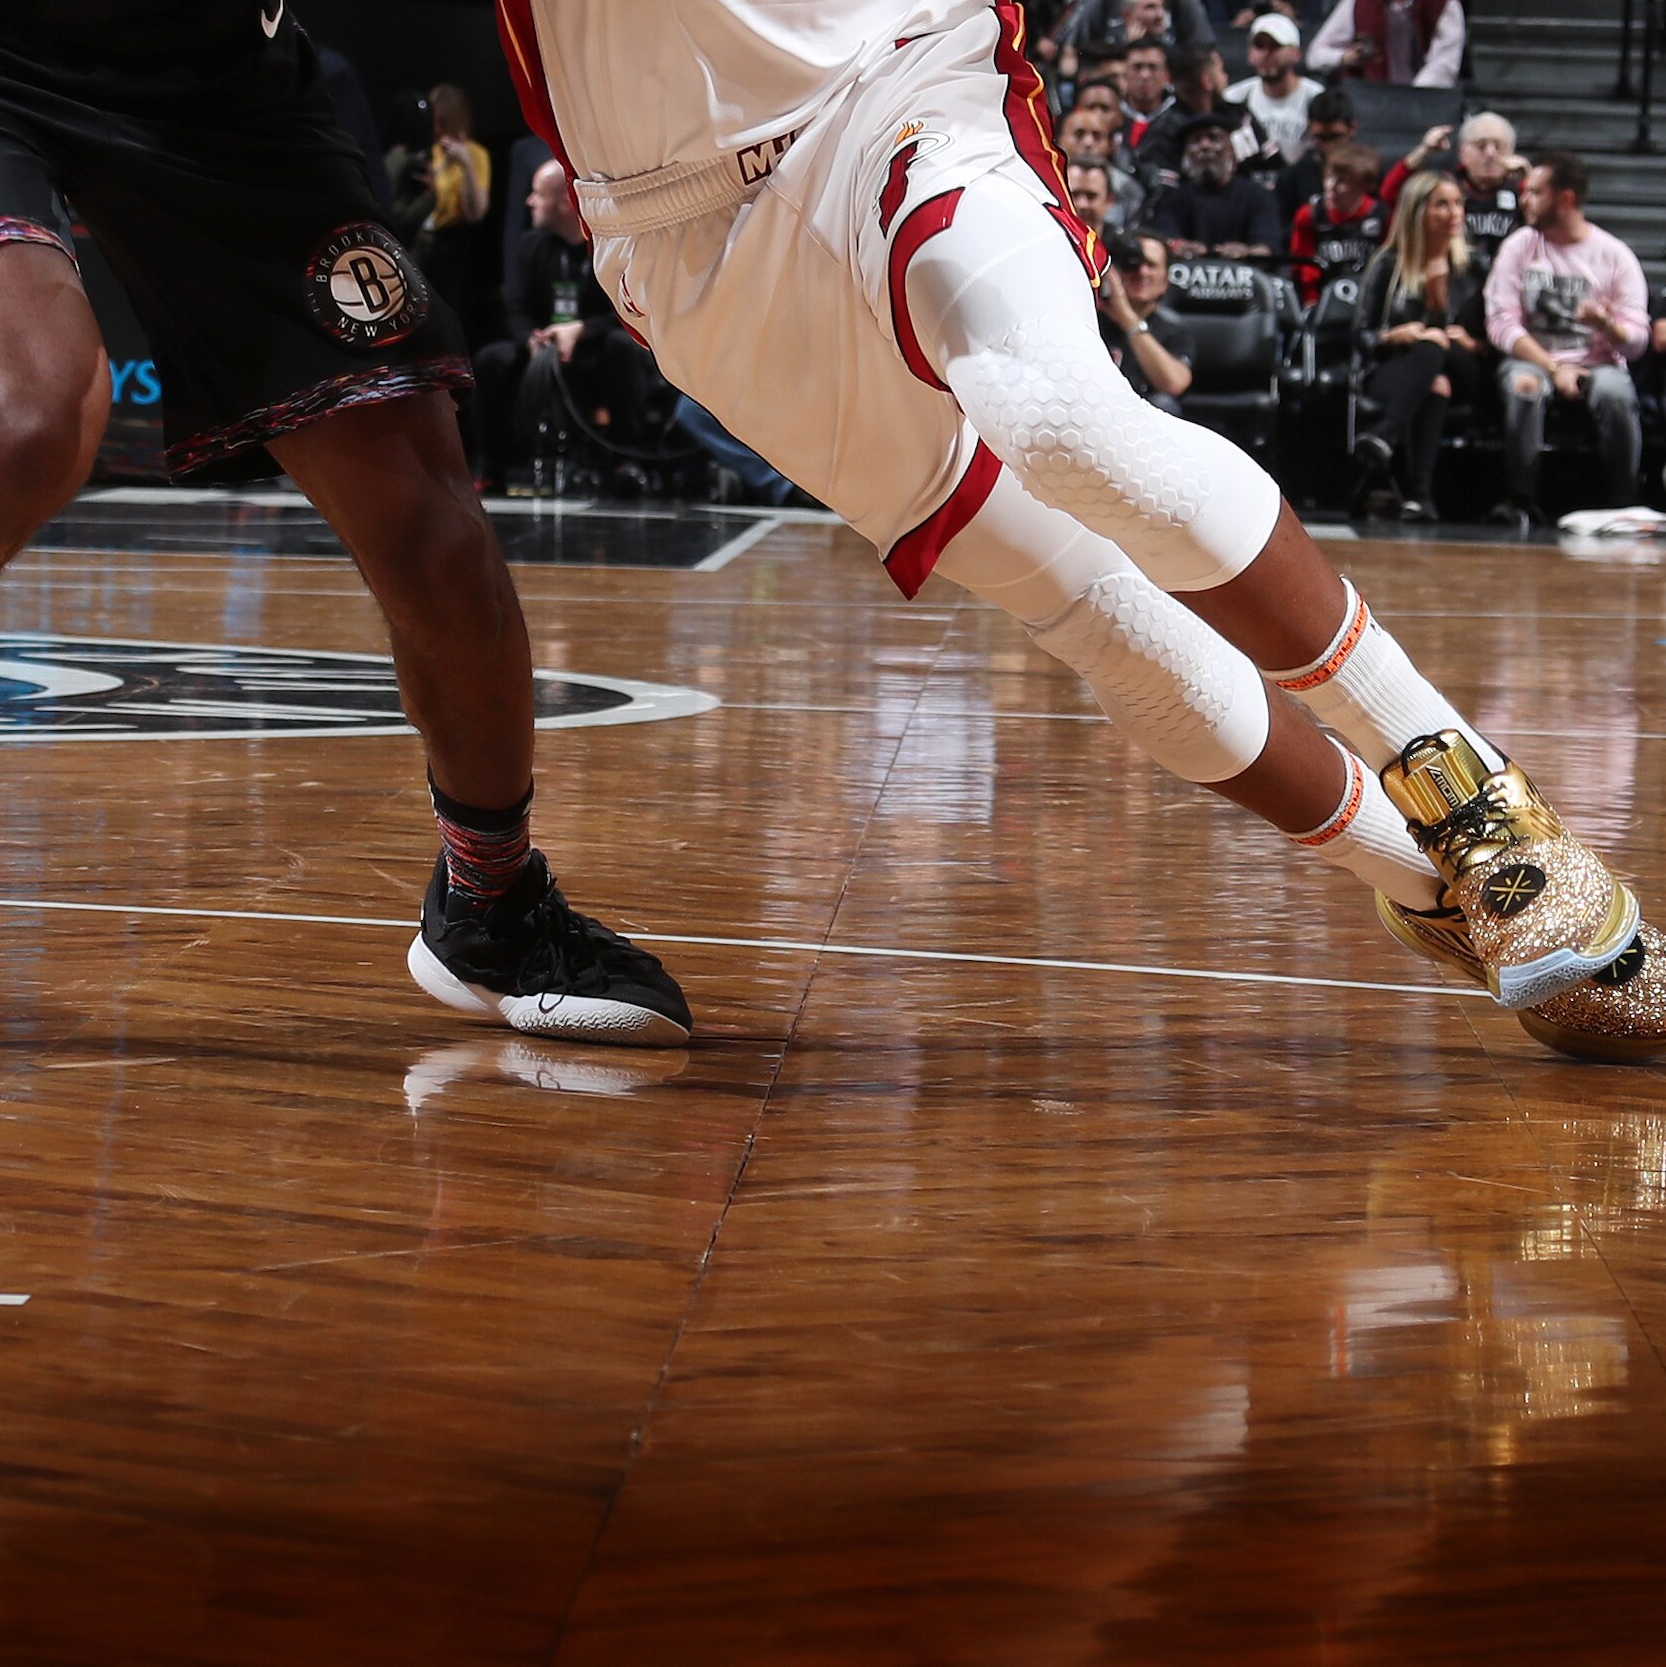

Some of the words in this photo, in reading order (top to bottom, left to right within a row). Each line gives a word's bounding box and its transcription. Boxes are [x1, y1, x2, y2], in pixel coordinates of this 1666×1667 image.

[1167, 262, 1255, 290] QATAR
[337, 316, 379, 338] NEW
[109, 359, 162, 405] YS
